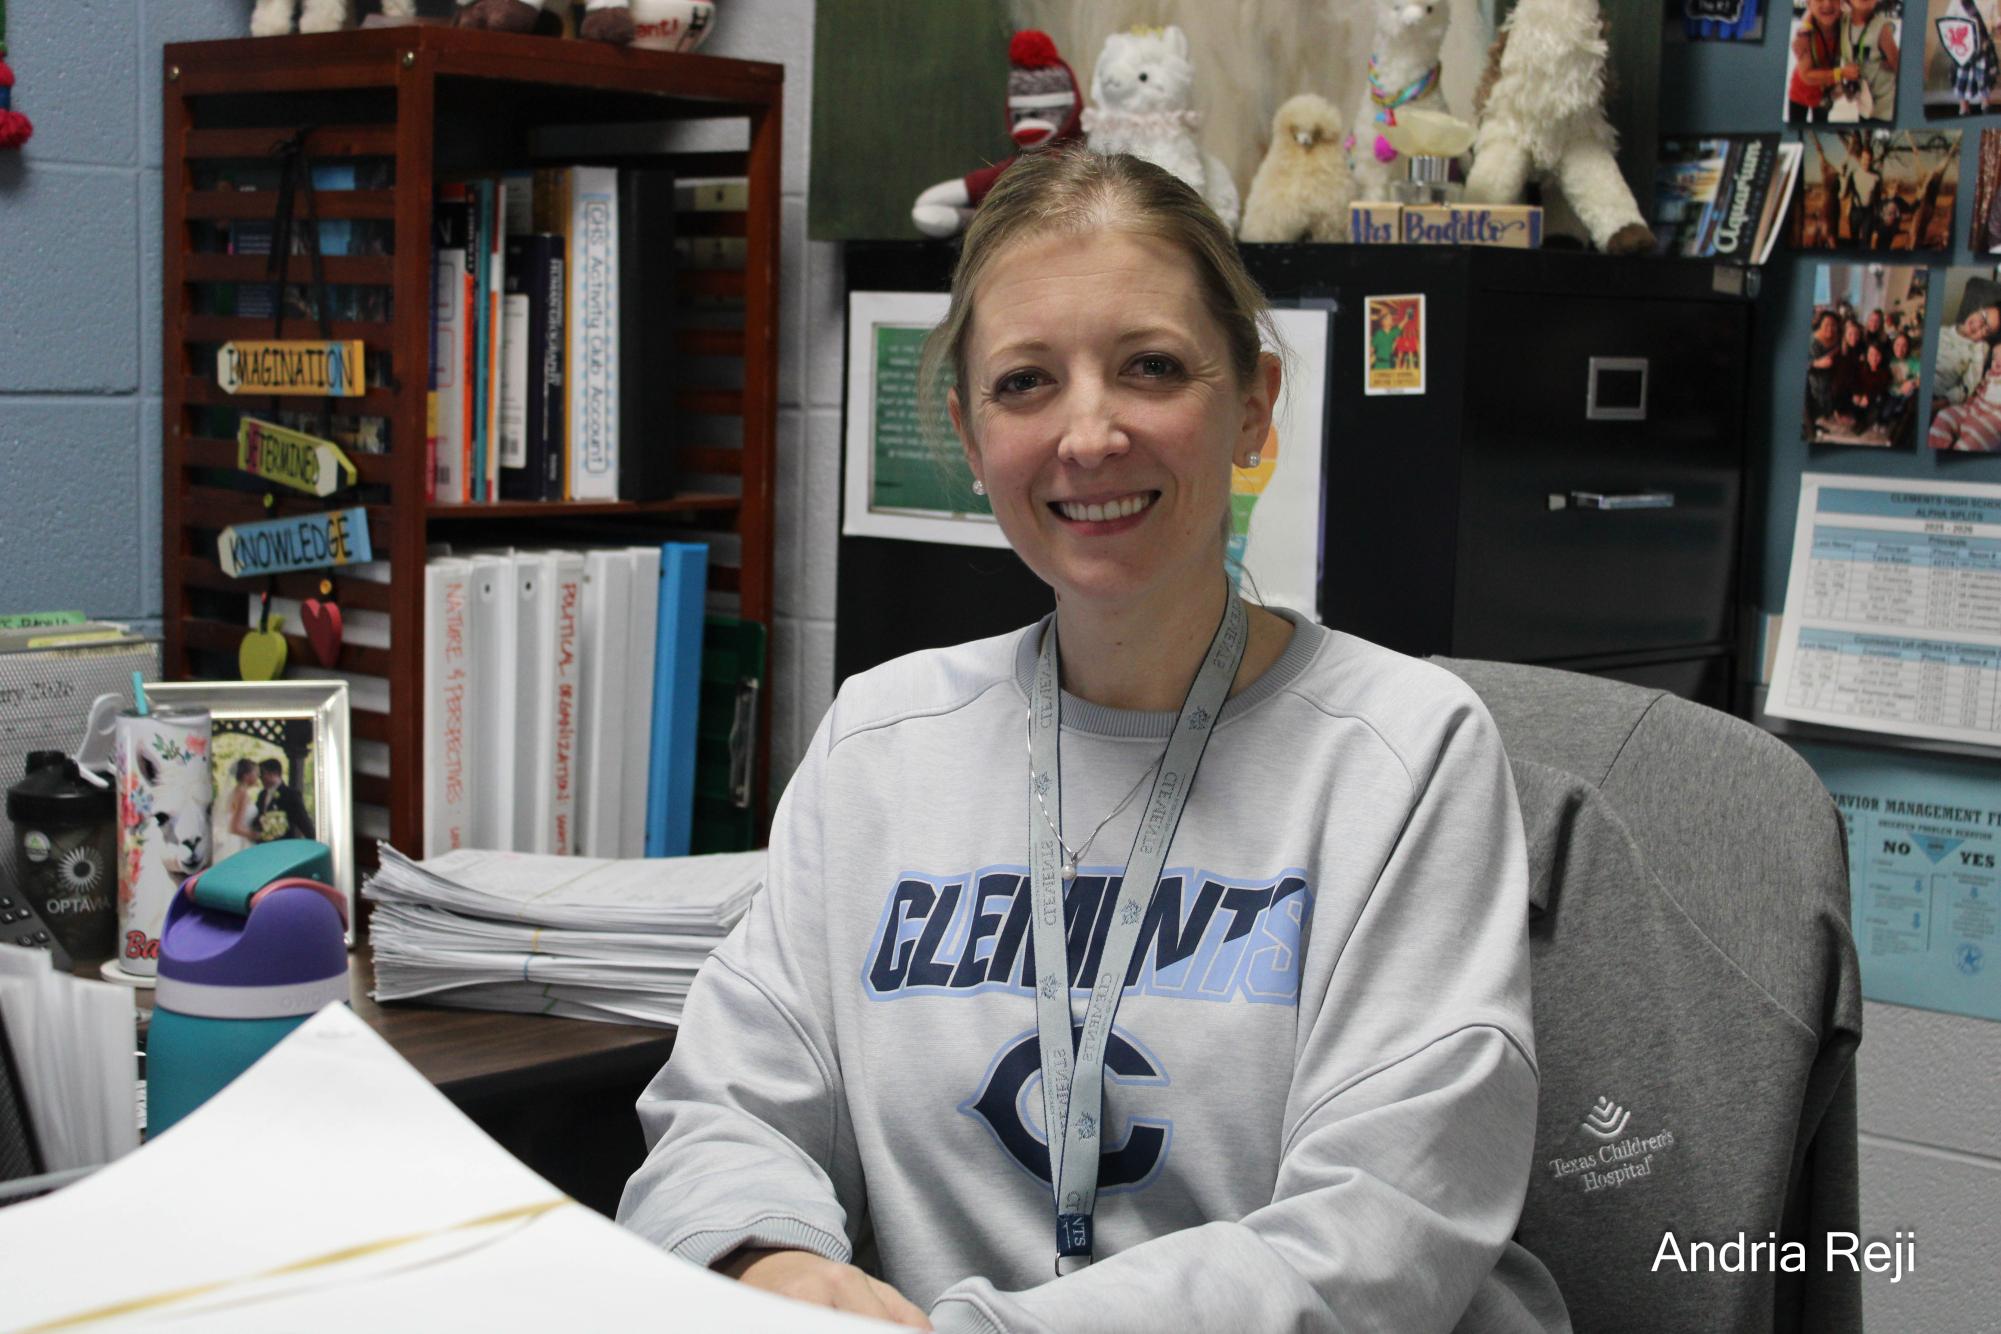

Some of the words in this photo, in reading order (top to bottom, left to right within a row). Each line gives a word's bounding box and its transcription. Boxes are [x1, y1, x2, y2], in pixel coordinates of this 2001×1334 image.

[1712, 139, 1763, 253] Aquarium
[590, 206, 606, 246] CHS
[588, 257, 605, 329] Activity
[227, 347, 354, 389] IMAGINATION
[590, 337, 606, 375] Club
[589, 386, 605, 463] Account
[244, 428, 322, 487] DETERMINED
[229, 516, 354, 574] KNOWLEDGE
[446, 582, 464, 664] NATURE
[558, 582, 577, 676] POLITICAL
[1885, 798, 1982, 824] MANAGEMENT
[1883, 840, 1910, 855] NO
[1960, 851, 1995, 868] YES
[1549, 1154, 1597, 1178] Texas
[1599, 1129, 1674, 1163] Children's
[1582, 1156, 1652, 1193] Hospital
